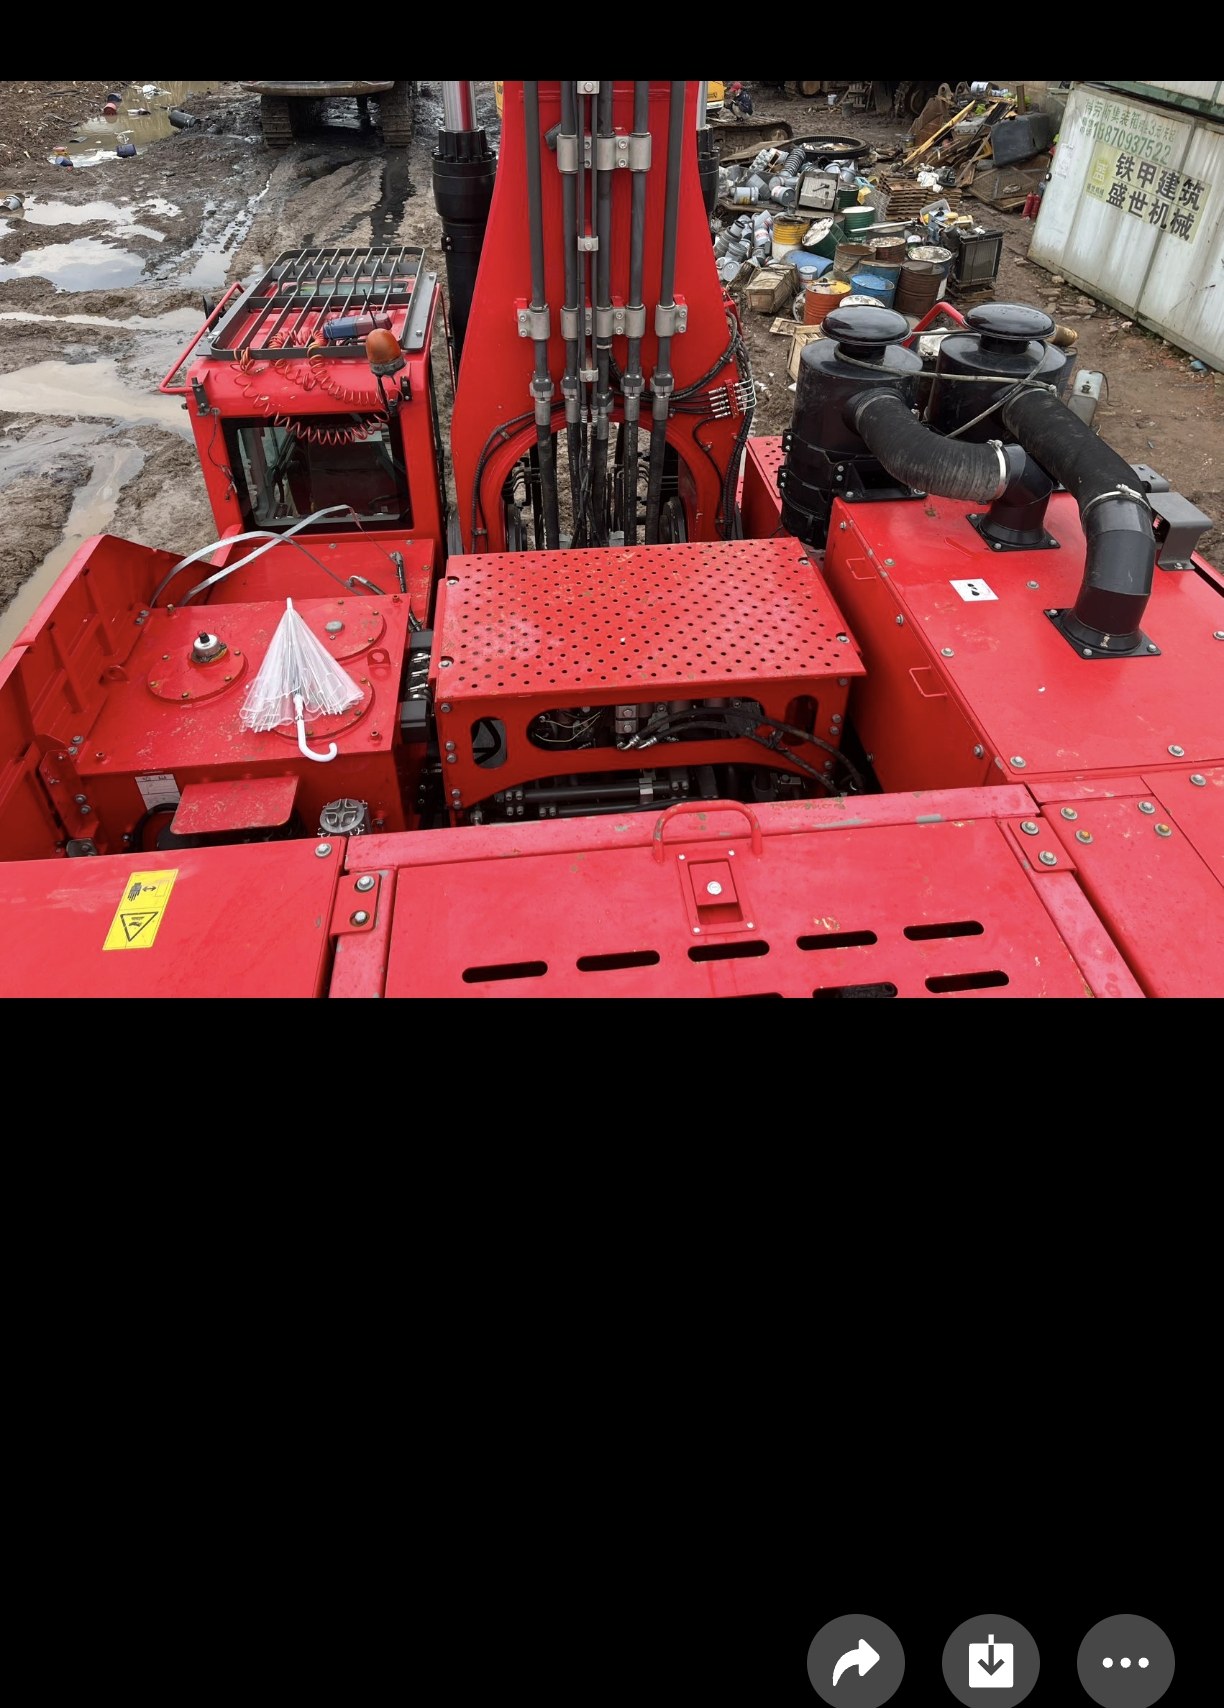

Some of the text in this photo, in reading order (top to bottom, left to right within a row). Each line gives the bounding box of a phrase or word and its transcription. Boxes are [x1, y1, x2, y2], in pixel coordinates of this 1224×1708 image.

[1092, 121, 1172, 165] 18870937522
[1115, 153, 1205, 211] 铁甲建筑
[1106, 182, 1195, 241] 盛世机械
